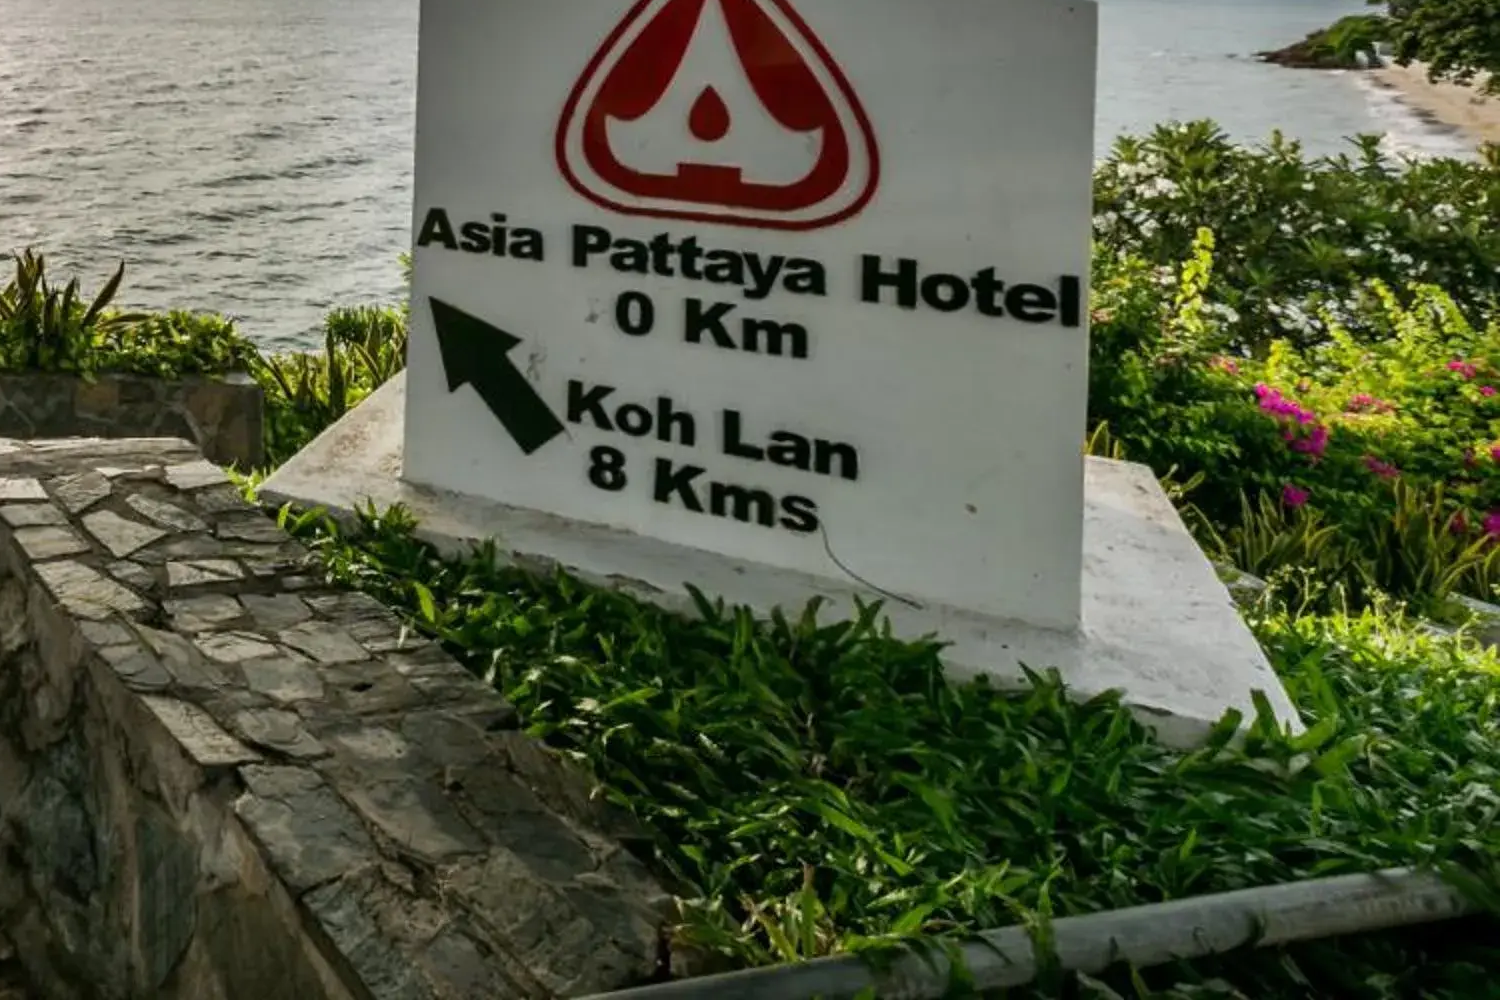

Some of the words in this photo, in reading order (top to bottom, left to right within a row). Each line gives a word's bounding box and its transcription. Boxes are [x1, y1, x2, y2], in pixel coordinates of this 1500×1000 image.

[416, 207, 545, 262] Asia
[571, 223, 828, 301] Pattaya
[860, 253, 1082, 328] Hotel
[614, 290, 656, 337] 0
[683, 297, 810, 360] Km
[566, 379, 697, 448] Koh
[721, 408, 860, 482] Lan
[587, 445, 628, 492] 8
[652, 457, 821, 534] Kms
